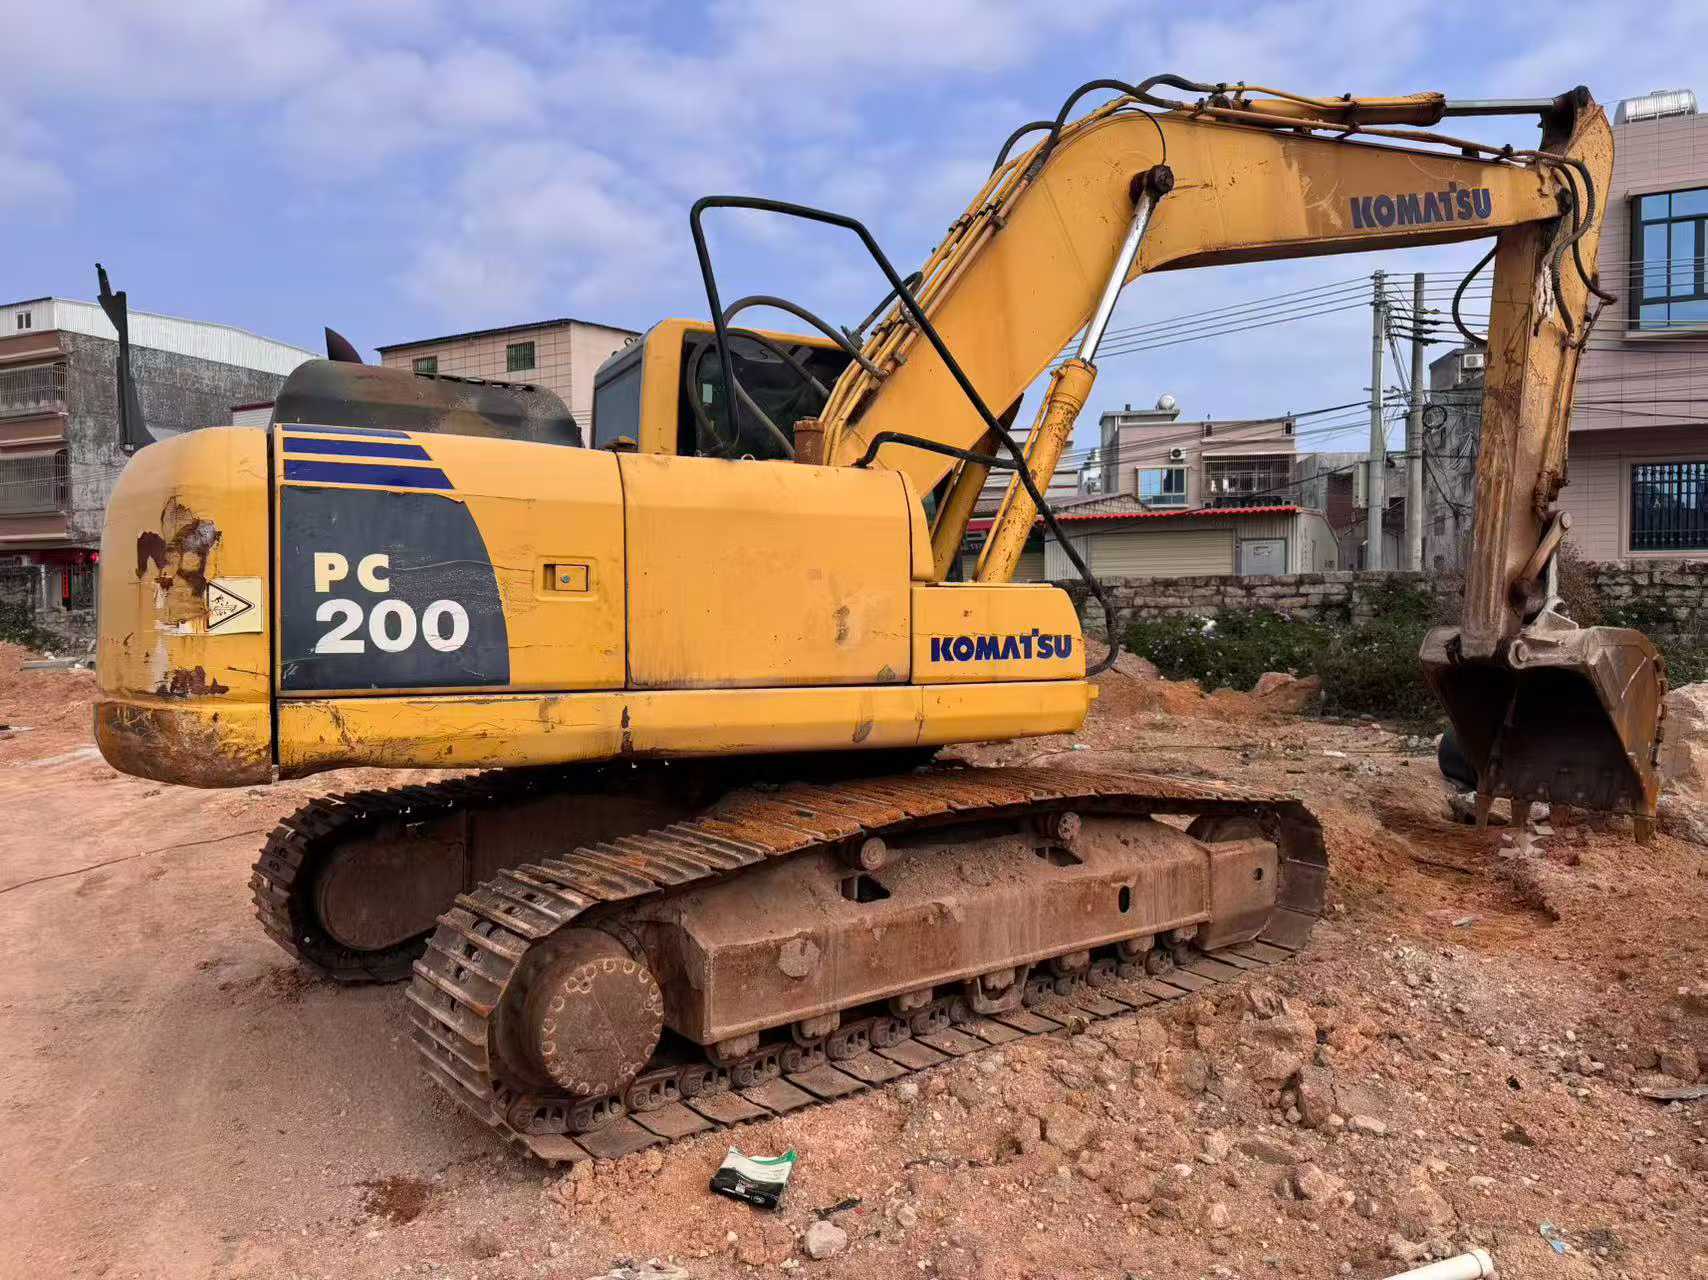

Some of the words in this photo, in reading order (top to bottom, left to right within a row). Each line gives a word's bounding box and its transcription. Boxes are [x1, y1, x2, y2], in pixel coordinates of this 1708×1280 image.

[1350, 182, 1492, 228] KOMATSU
[314, 552, 390, 592] PC
[315, 599, 469, 653] 200
[931, 628, 1071, 662] KOMATSU
